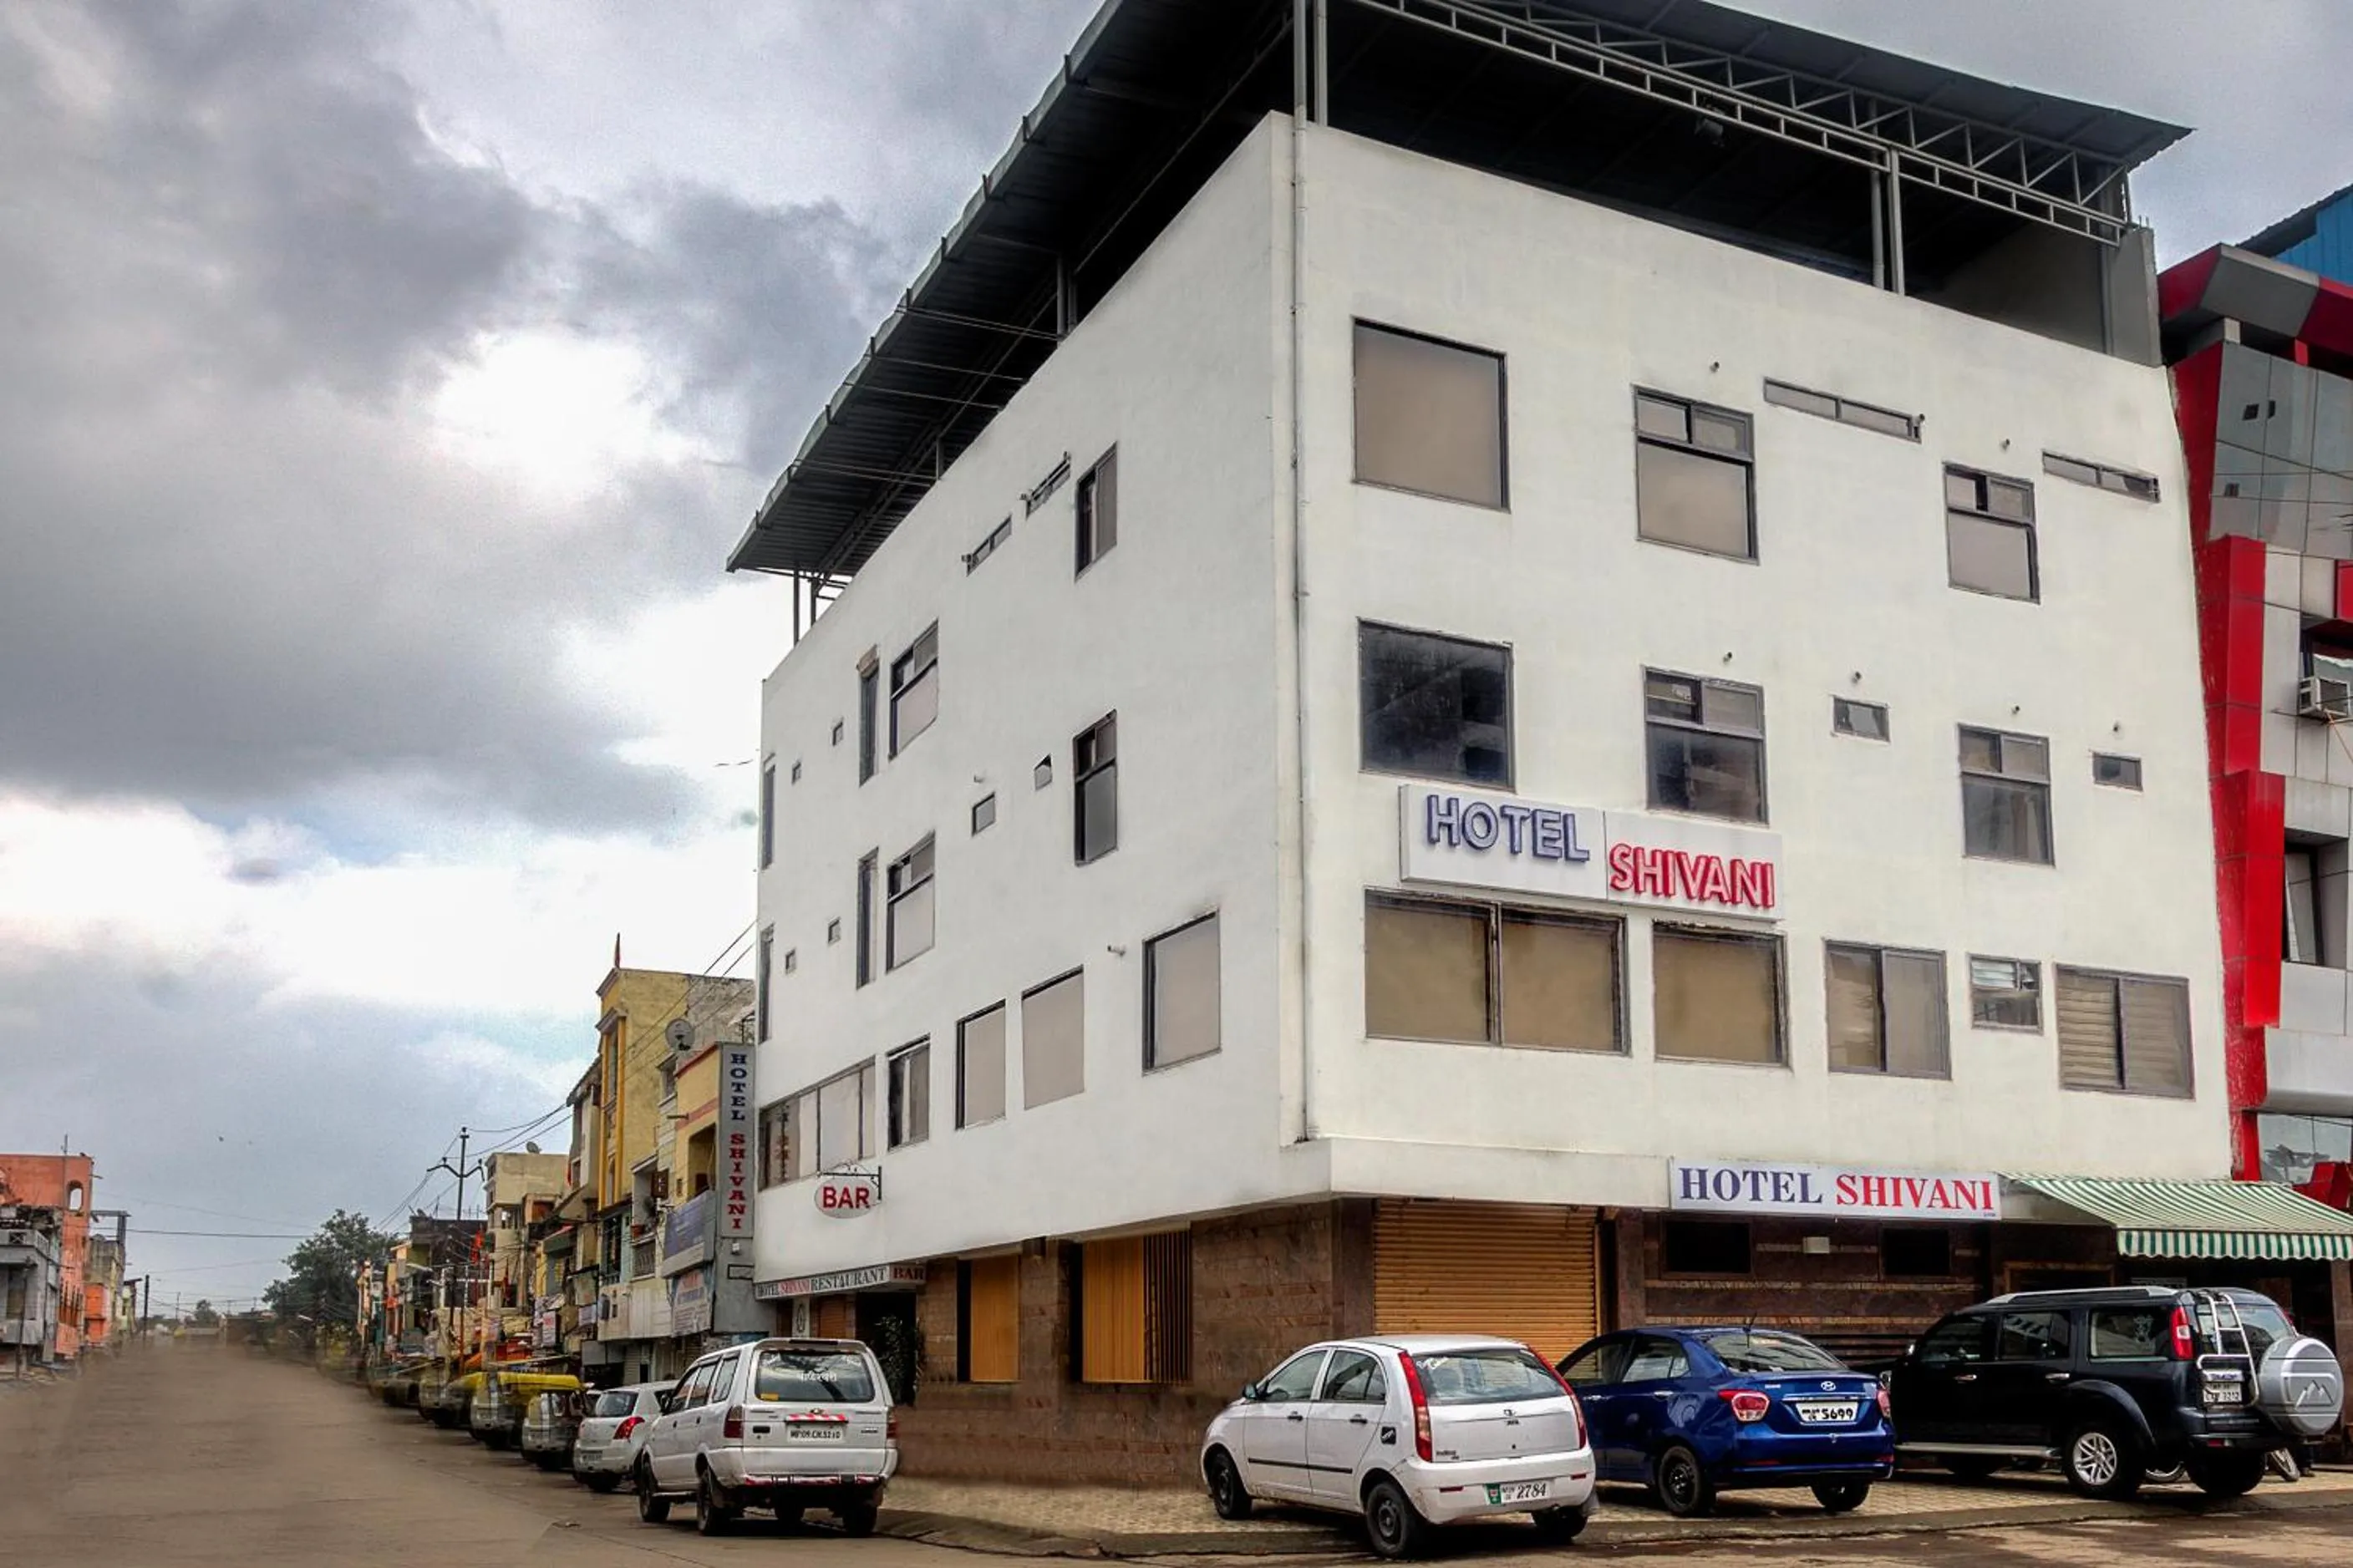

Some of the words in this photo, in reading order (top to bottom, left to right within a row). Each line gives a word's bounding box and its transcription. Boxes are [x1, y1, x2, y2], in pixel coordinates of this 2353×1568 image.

[1426, 794, 1590, 862] HOTEL
[1609, 843, 1776, 909] SHIVANI
[729, 1053, 748, 1121] HOTEL
[728, 1133, 747, 1230] SHIVANI
[822, 1185, 871, 1209] BAR
[1678, 1167, 1823, 1205] HOTEL
[1835, 1174, 1995, 1210] SHIVANI
[811, 1266, 887, 1292] RESTAURANT
[1516, 1482, 1547, 1499] 2784
